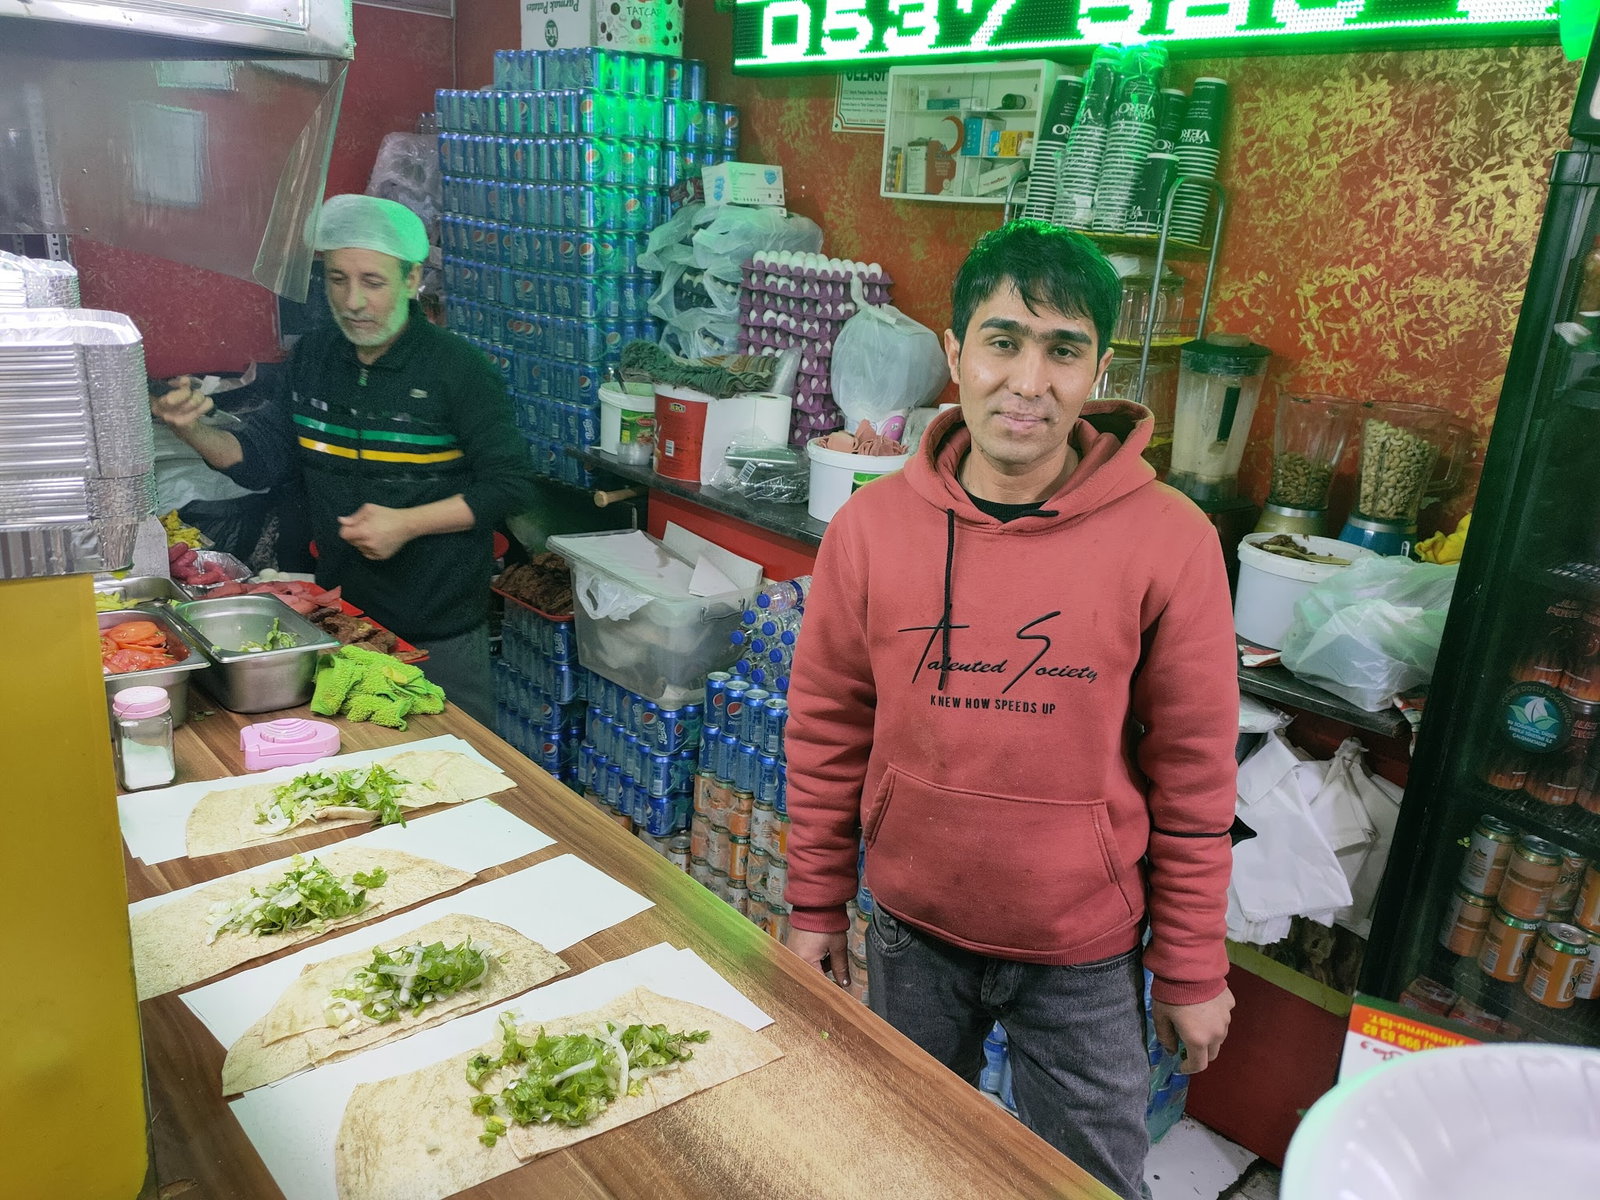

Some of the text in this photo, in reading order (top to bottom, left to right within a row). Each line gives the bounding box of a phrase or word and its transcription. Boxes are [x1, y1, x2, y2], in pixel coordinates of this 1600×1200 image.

[1002, 611, 1098, 694] Society
[930, 695, 1056, 715] KNEW HOW SPEEDS UP
